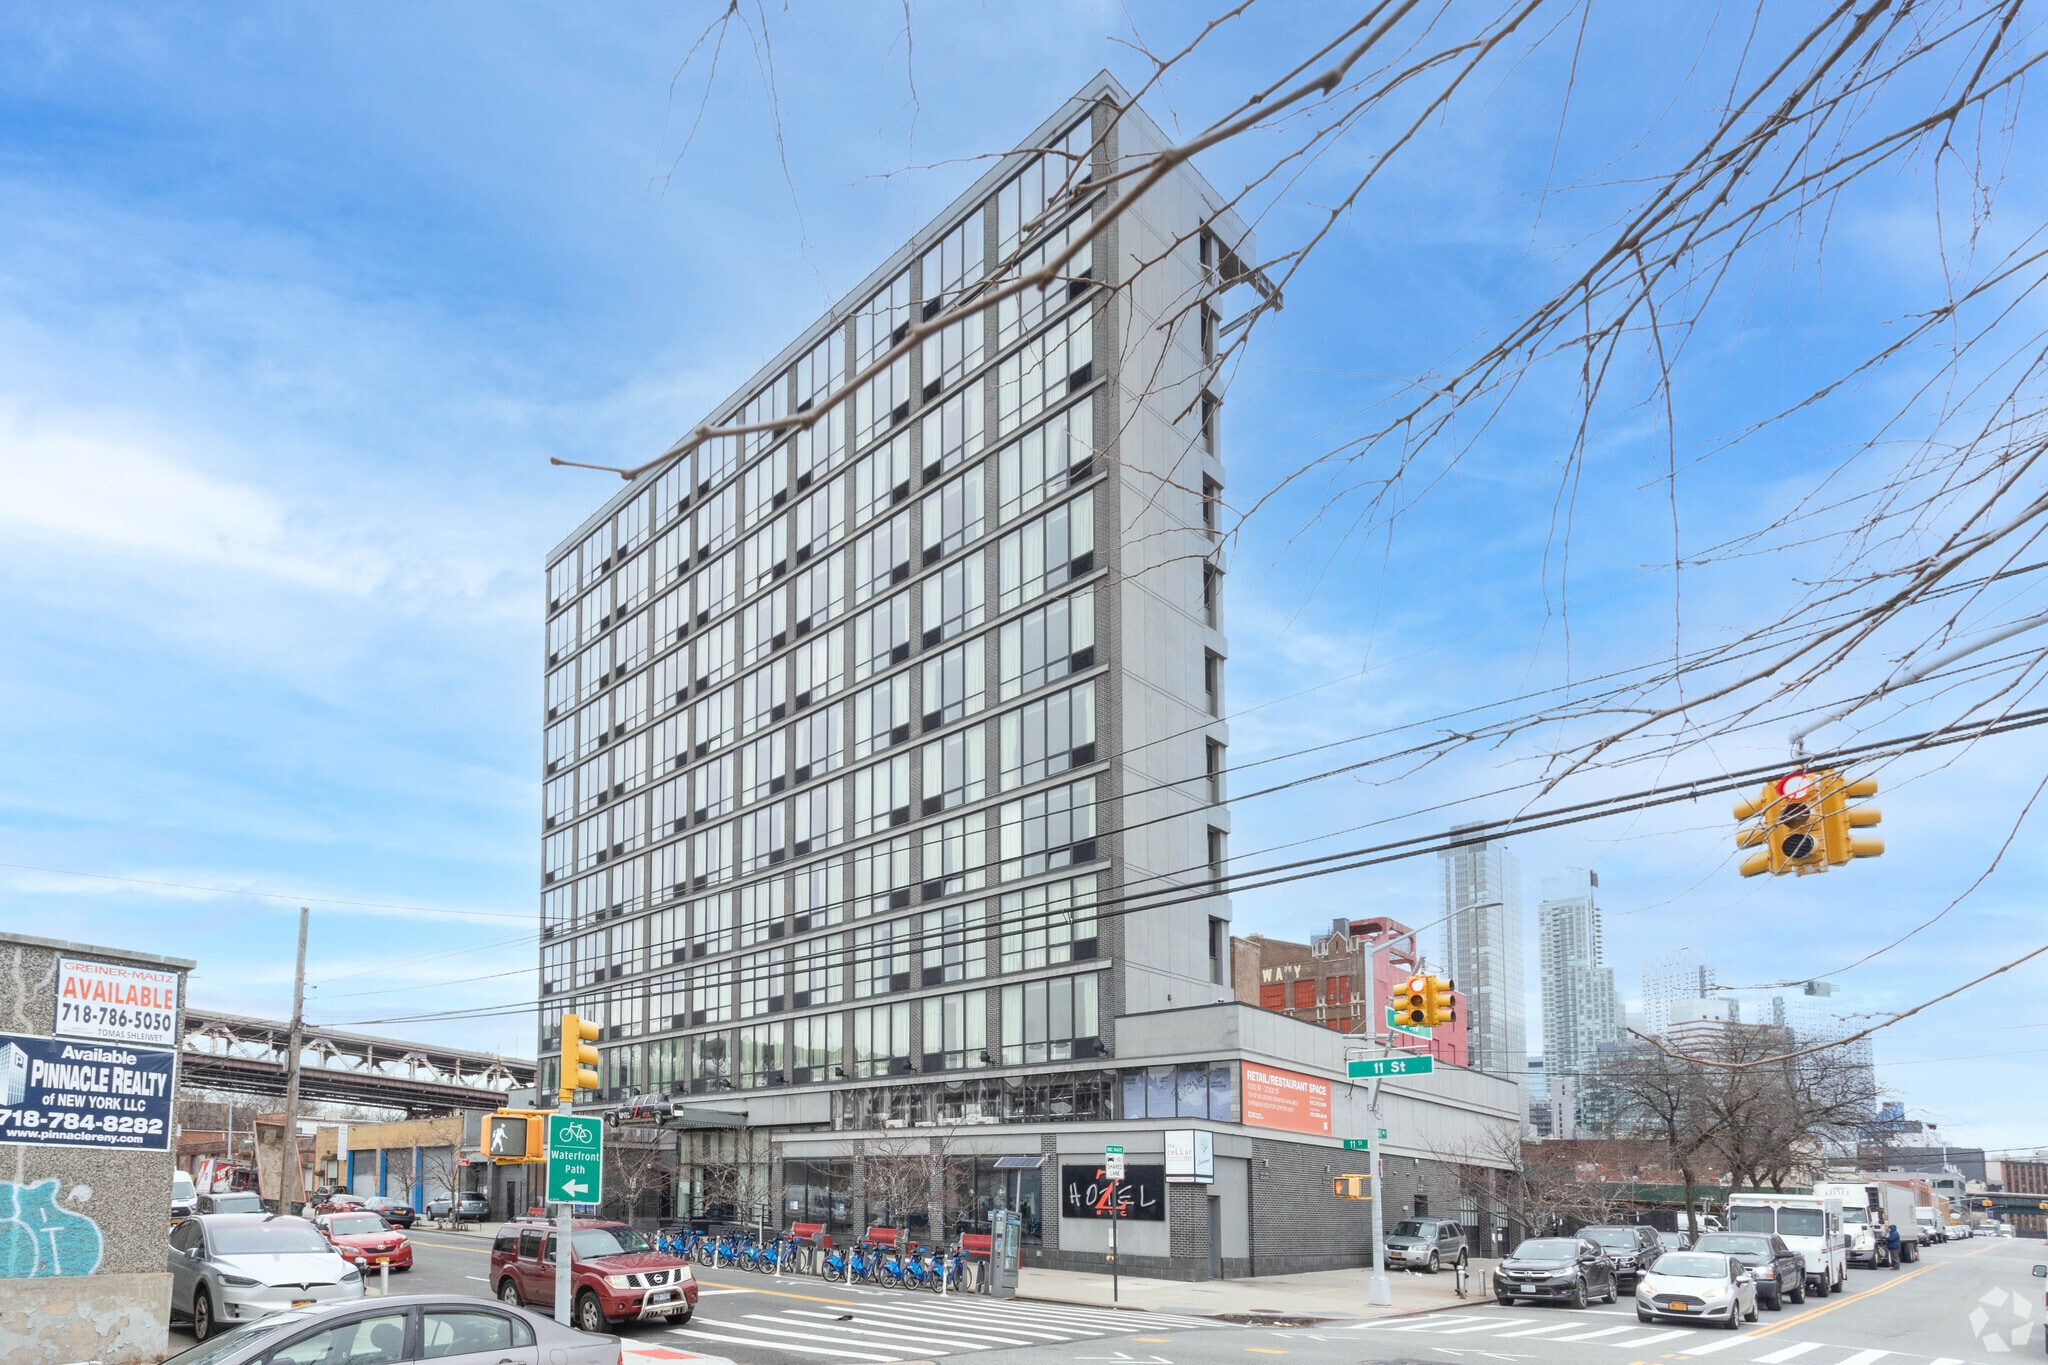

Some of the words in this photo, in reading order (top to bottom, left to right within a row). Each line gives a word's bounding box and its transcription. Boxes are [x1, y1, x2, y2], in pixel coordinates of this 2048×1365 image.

[64, 962, 174, 983] GREINER-MALTZ
[62, 976, 173, 1010] AVAILABLE
[62, 1002, 171, 1032] 718-786-5050
[98, 1028, 125, 1038] TOMAS
[61, 1045, 137, 1065] Available
[1374, 1062, 1384, 1074] 11
[1391, 1061, 1406, 1073] St
[31, 1059, 110, 1094] PINNACLE
[112, 1066, 168, 1097] REALTY
[1247, 1070, 1308, 1092] RETAIL/RESTAURANT
[1308, 1083, 1326, 1096] SPACE
[42, 1093, 55, 1106] of
[58, 1094, 86, 1108] NEW
[88, 1096, 121, 1110] YORK
[124, 1099, 146, 1112] LLC
[0, 1109, 164, 1134] 718-784-8282
[6, 1129, 144, 1144] www.pinnaclereny.com
[1350, 1140, 1355, 1148] 11
[551, 1150, 599, 1162] Waterfront
[565, 1165, 585, 1174] Path
[1070, 1182, 1156, 1207] HOTEL
